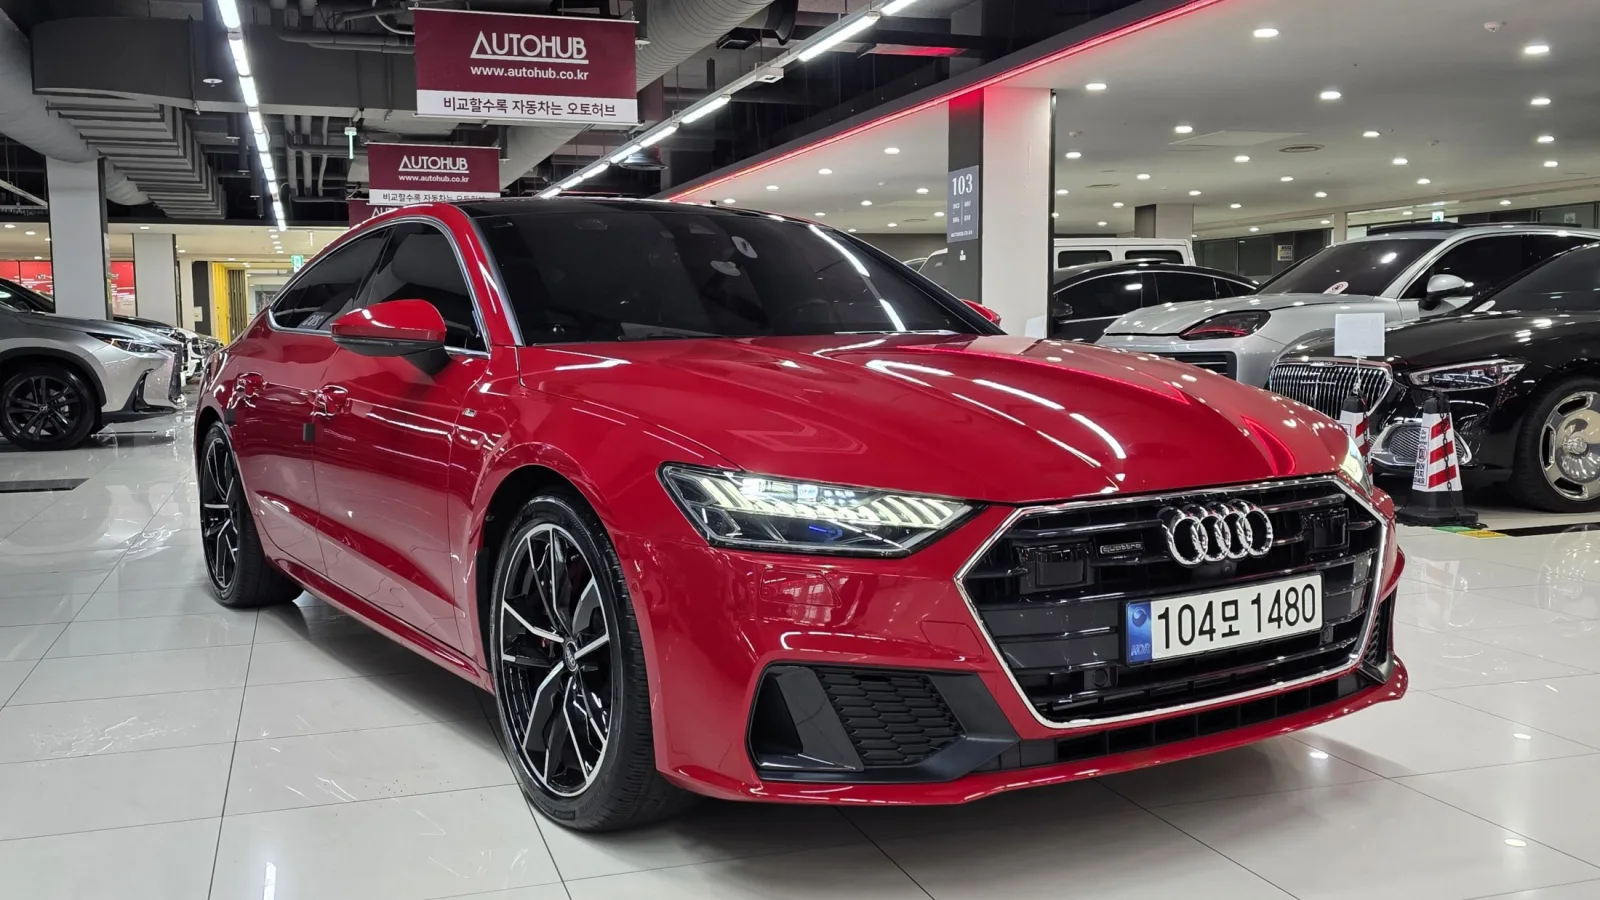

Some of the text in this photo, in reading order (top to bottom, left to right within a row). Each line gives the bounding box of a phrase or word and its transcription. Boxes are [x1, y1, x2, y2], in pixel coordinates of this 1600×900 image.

[470, 31, 589, 64] AUTOHUB
[470, 66, 589, 80] www.autohub.co.kr
[443, 97, 616, 117] 비교할수록 자동차는 오토허브
[399, 155, 469, 173] AUTOHUB
[398, 174, 470, 183] www.autohub.co.kr
[952, 173, 973, 196] 103
[382, 193, 421, 203] 비교할수록
[1157, 583, 1315, 650] 104모 1480
